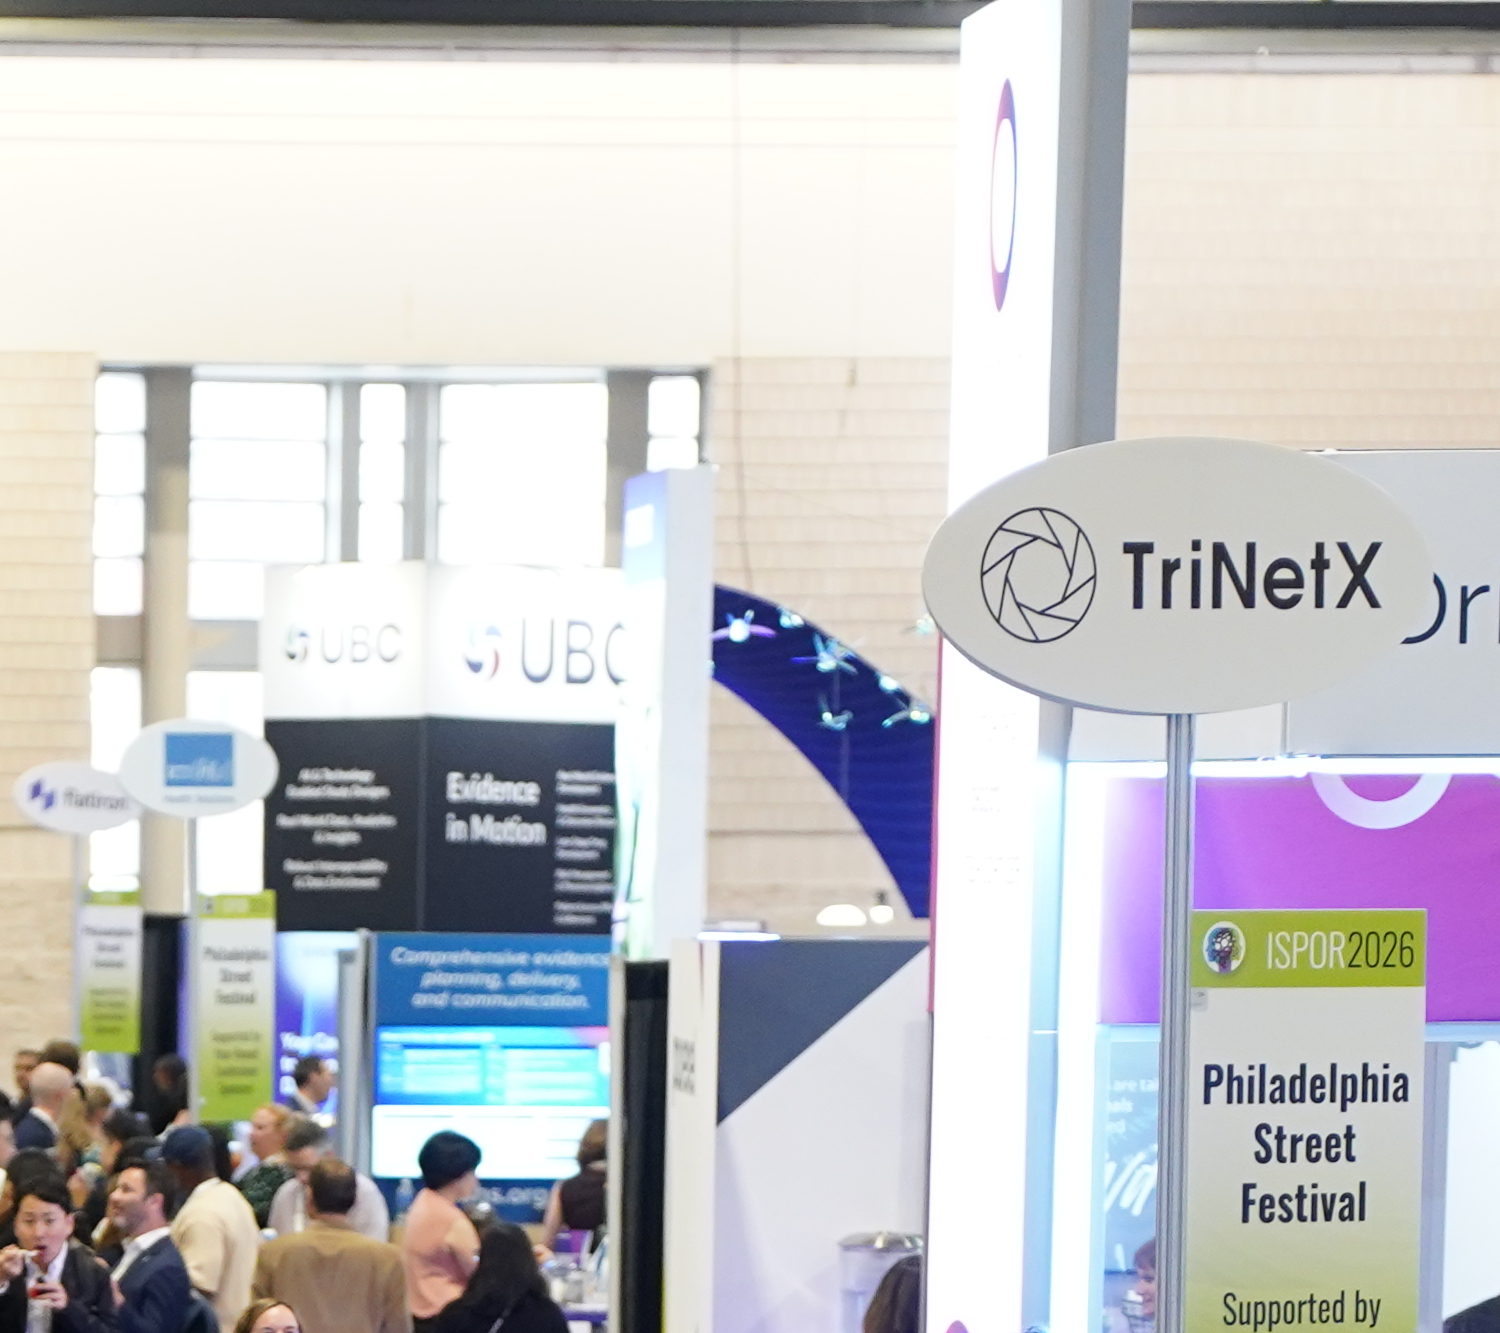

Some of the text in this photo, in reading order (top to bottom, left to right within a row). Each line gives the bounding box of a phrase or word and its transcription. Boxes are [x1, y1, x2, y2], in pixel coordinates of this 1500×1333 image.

[1122, 541, 1381, 611] TriNetX
[321, 624, 401, 663] UBC
[446, 771, 541, 806] Evidence
[445, 812, 547, 846] in Motion
[391, 946, 529, 968] Comprehensive
[412, 992, 449, 1010] and
[1203, 1062, 1410, 1112] Philadelphia
[1254, 1123, 1356, 1164] Street
[1241, 1181, 1367, 1224] Festival
[1223, 1290, 1381, 1333] Supported by
